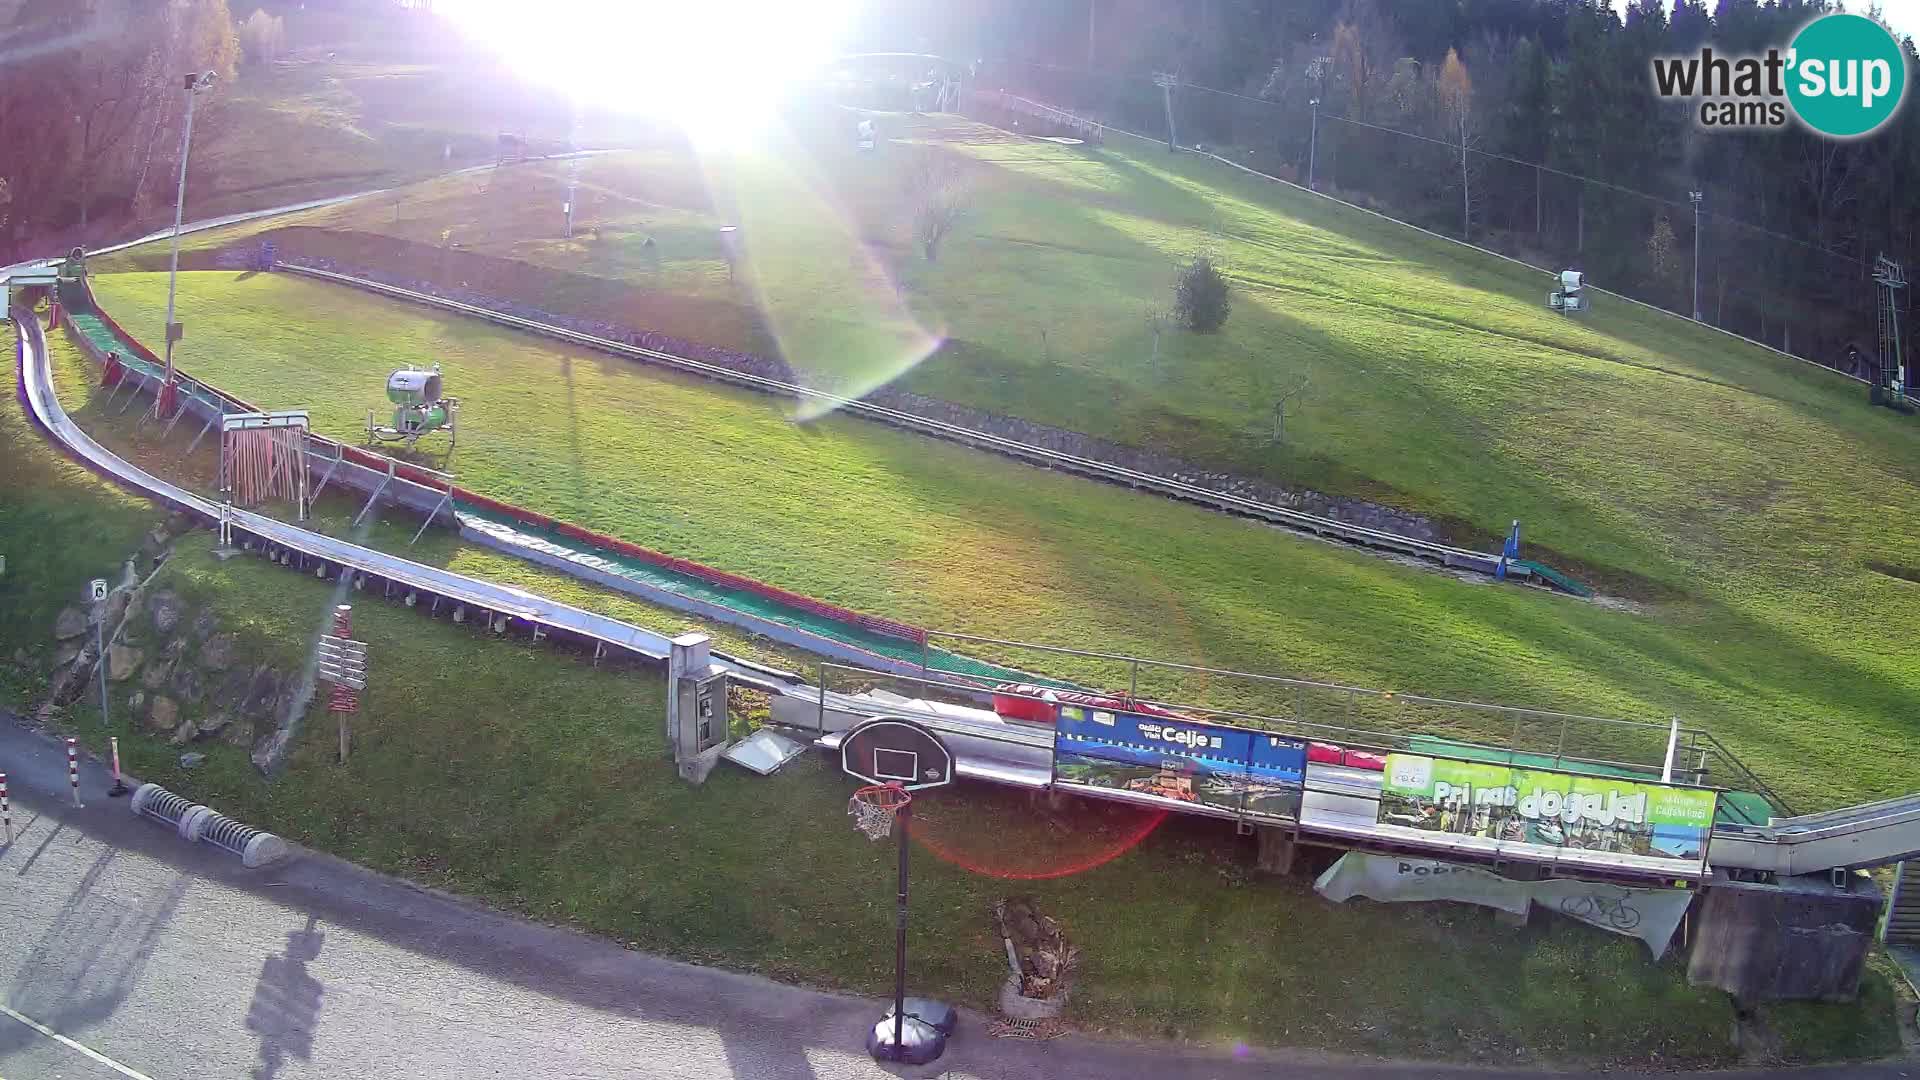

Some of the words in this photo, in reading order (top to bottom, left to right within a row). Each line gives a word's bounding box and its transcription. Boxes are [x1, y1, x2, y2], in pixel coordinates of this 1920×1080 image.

[1162, 727, 1208, 749] Celje
[1433, 781, 1470, 805] Pri
[1474, 786, 1518, 806] nas
[1518, 786, 1646, 826] dogaja!
